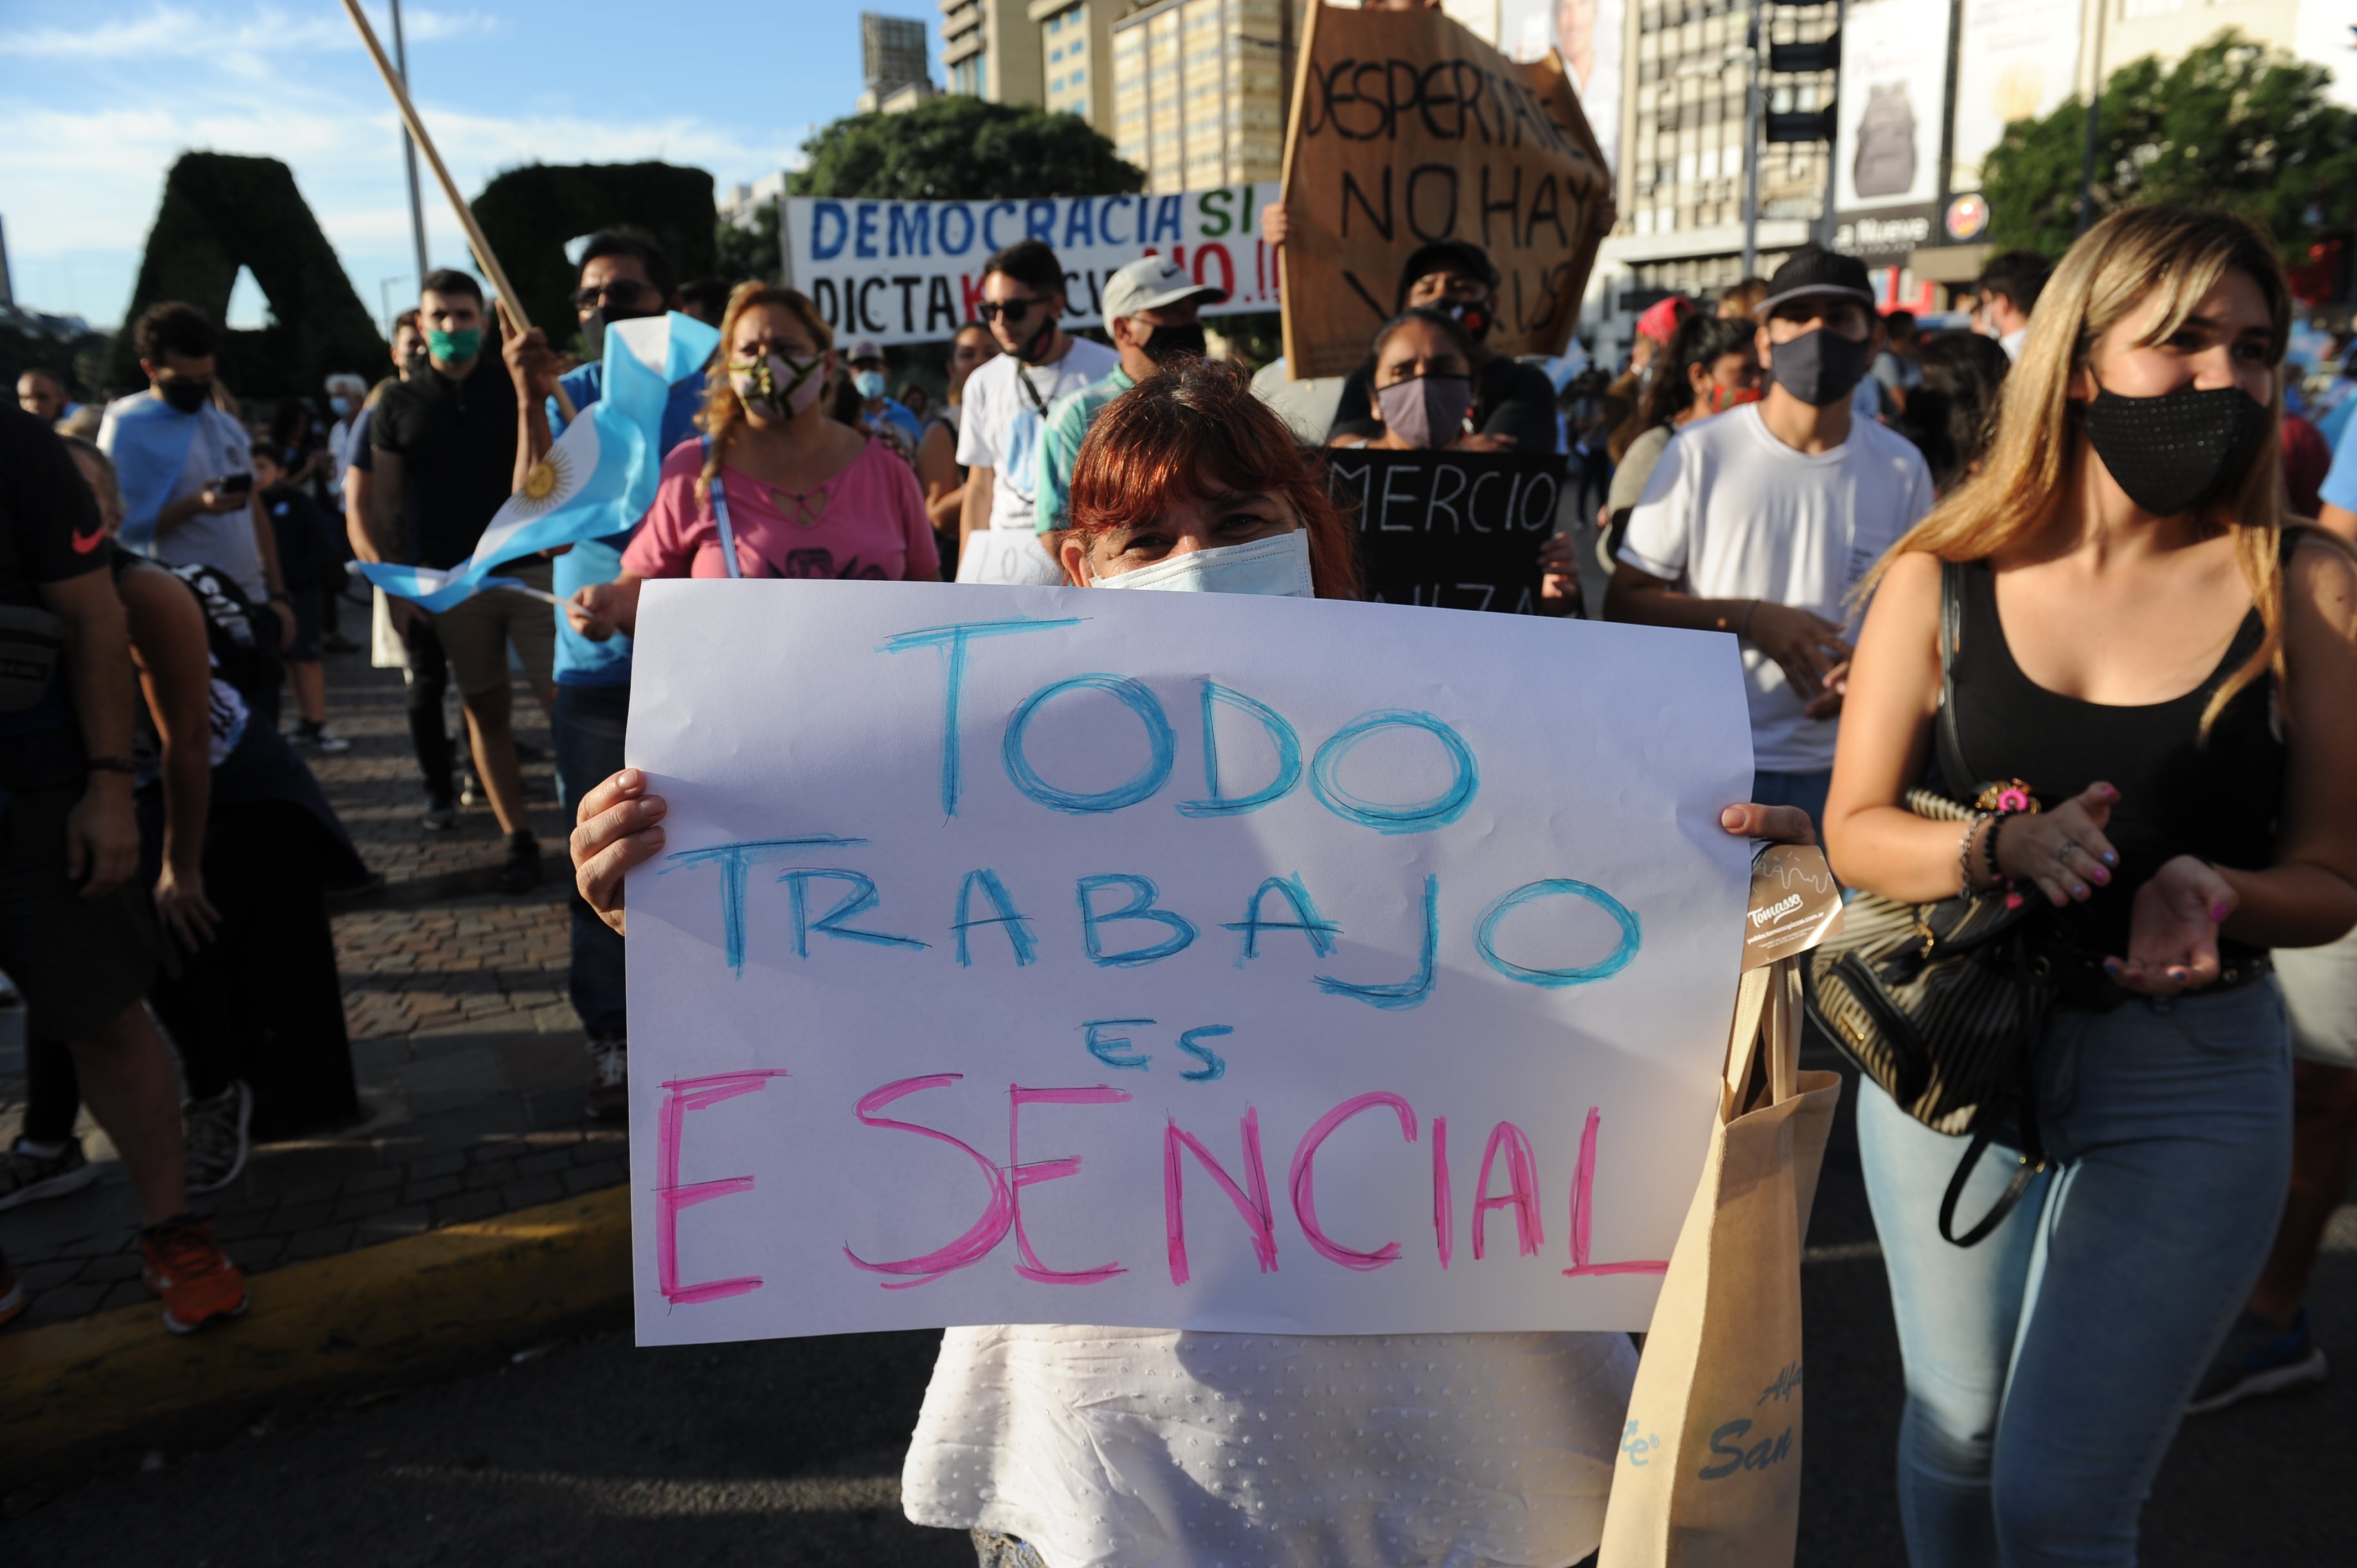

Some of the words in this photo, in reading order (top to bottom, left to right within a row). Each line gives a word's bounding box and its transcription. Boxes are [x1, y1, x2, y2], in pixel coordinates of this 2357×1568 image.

[811, 194, 1182, 260] DEMOCRACIA
[1199, 185, 1254, 237] SI
[1341, 163, 1459, 243] NO
[1480, 164, 1592, 249] HAY
[874, 616, 1480, 835] TODO
[658, 838, 1641, 1010] TRABAJO
[1747, 893, 1804, 928] Tomasso
[1082, 1018, 1234, 1081] ES
[652, 1069, 1669, 1316] ESENCIAL
[1698, 1418, 1793, 1481] San
